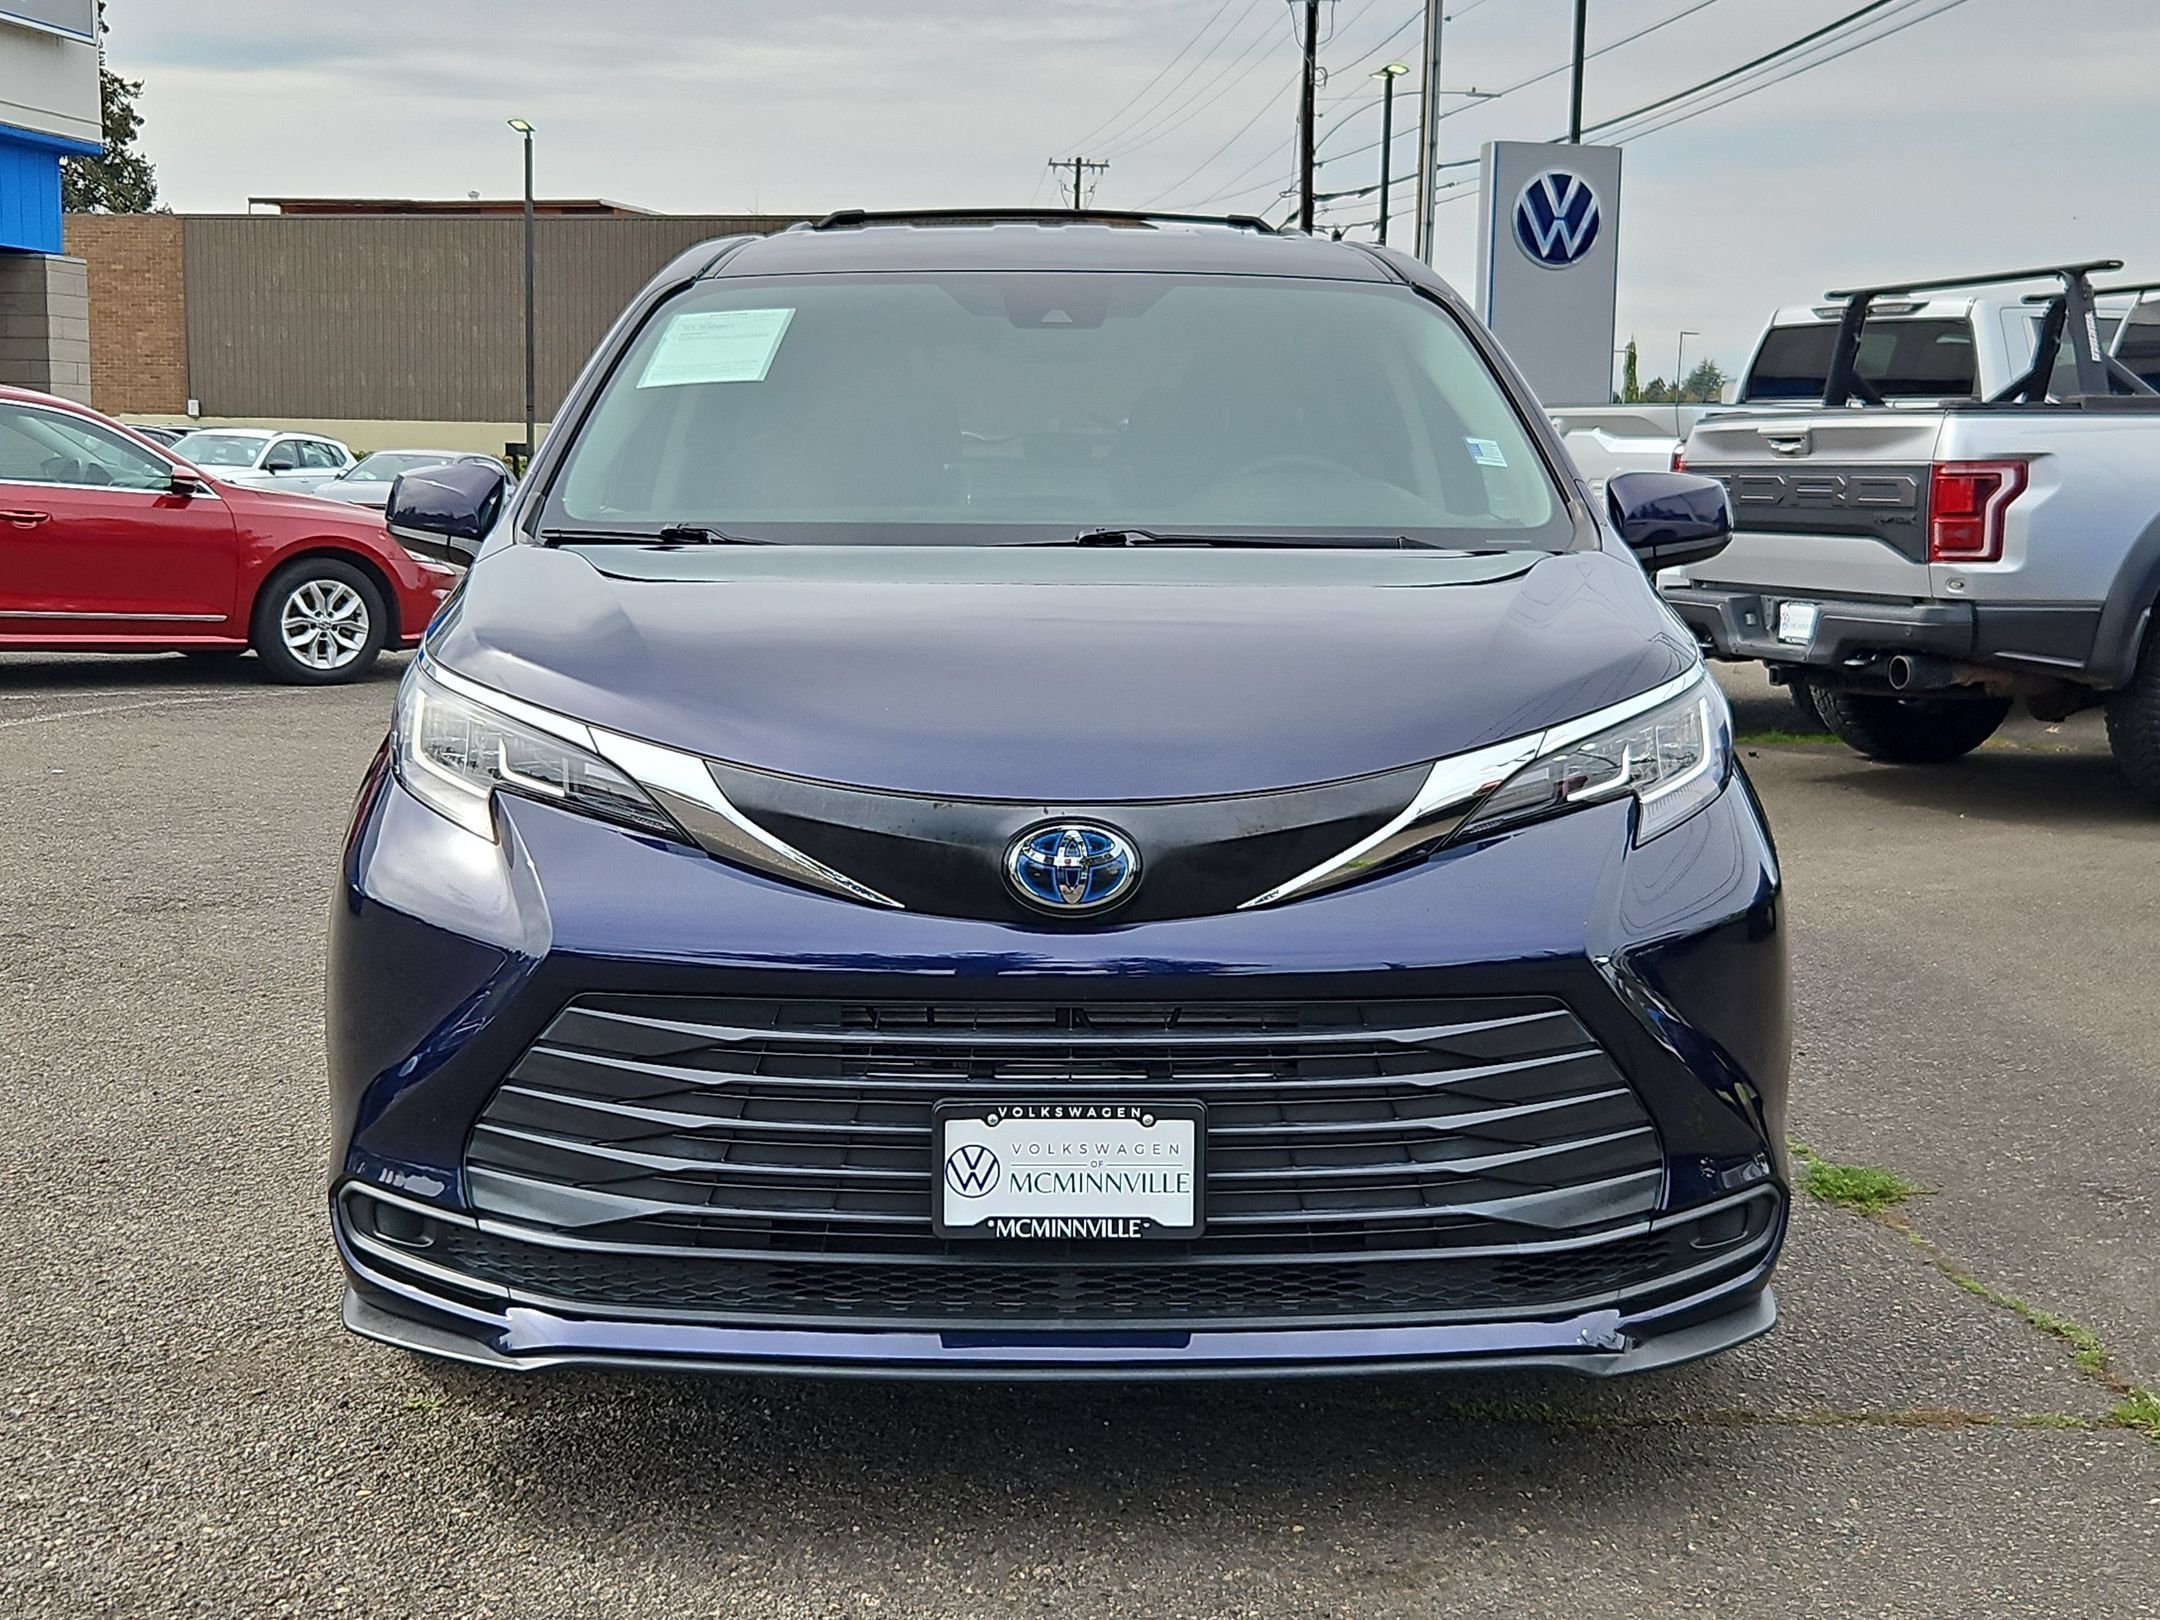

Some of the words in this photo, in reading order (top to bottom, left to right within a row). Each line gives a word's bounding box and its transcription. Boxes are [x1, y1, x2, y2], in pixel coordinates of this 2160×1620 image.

[1702, 474, 1918, 508] ORD
[997, 1106, 1142, 1118] VOLKSWAGEN
[1011, 1143, 1181, 1155] VOLKSWAGEN
[1090, 1160, 1104, 1169] OF
[1009, 1171, 1190, 1194] MCMINNVILLE
[996, 1219, 1142, 1238] MCMINNVILLE
